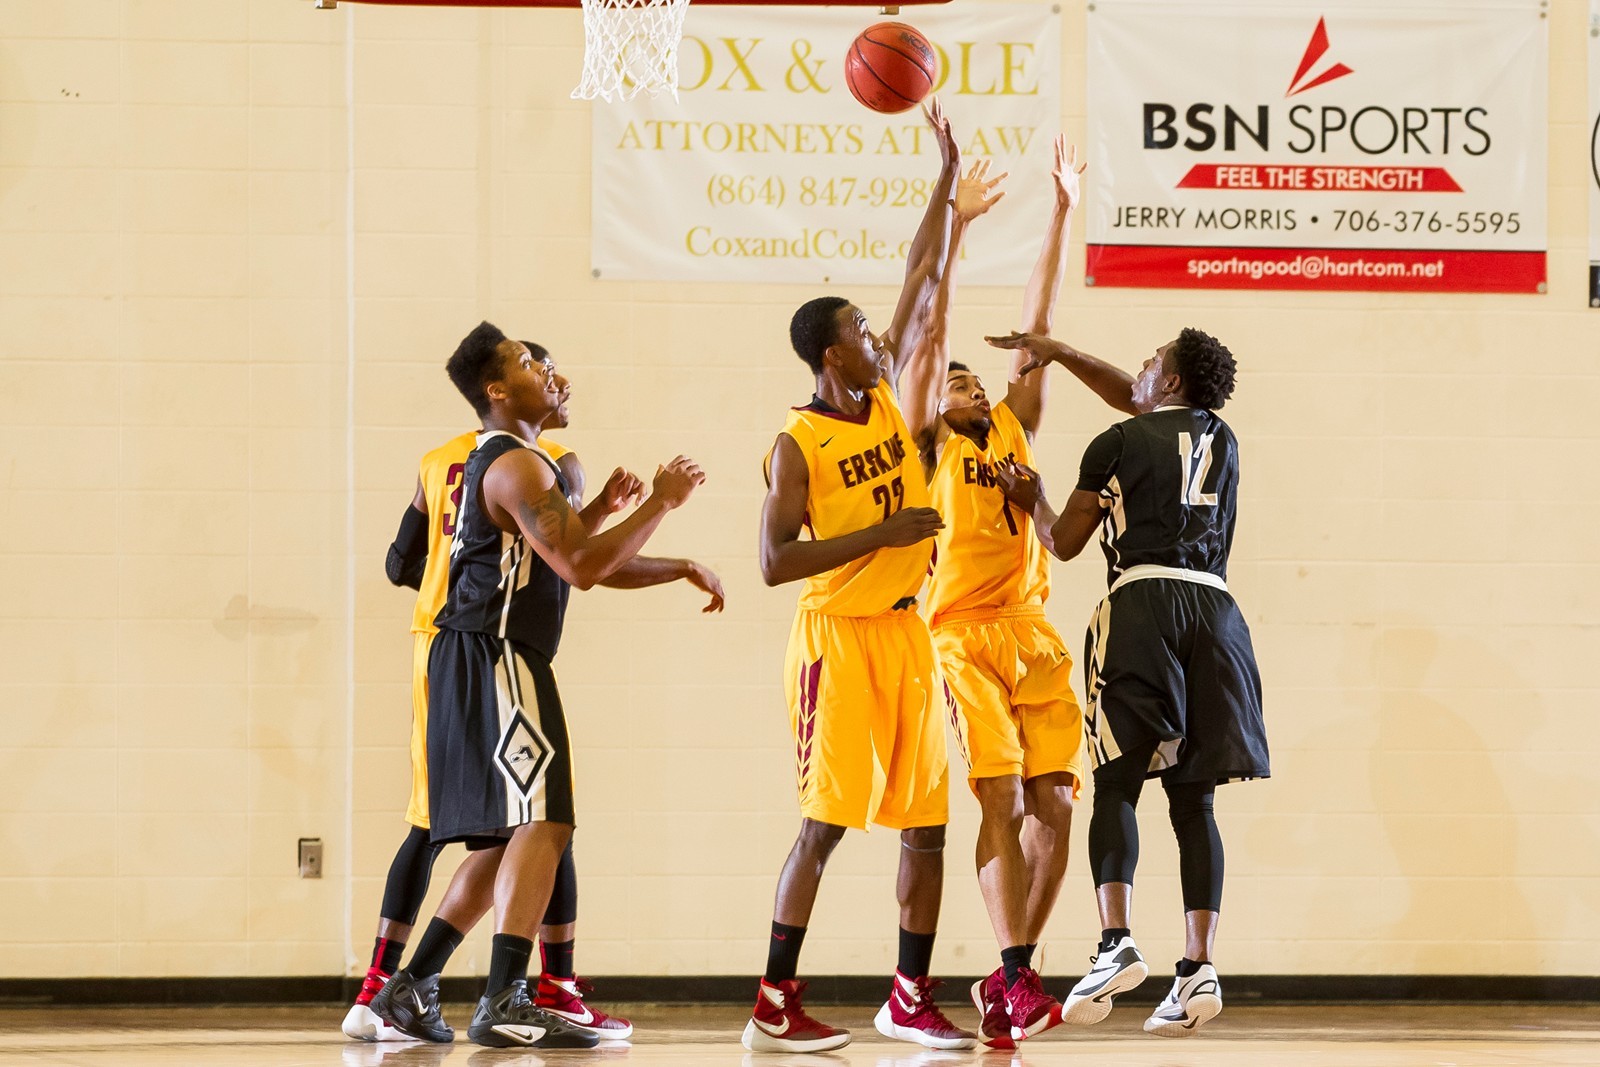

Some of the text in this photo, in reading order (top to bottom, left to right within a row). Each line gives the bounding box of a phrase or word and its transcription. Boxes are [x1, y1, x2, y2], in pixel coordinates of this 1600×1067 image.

[784, 38, 832, 94] &
[616, 121, 1037, 156] ATTORNEYS AT AW
[1143, 103, 1492, 156] BSN SPORTS
[706, 174, 938, 209] (864) 847-928
[1216, 167, 1424, 191] FEEL THE STRENGTH
[1113, 206, 1521, 235] JERRY MORRIS 706-376-5595
[685, 226, 968, 260] CoxandCole.c
[1187, 256, 1445, 280] sportngood@hartcom.net
[837, 431, 906, 489] ERSKINE
[1178, 431, 1218, 506] 12
